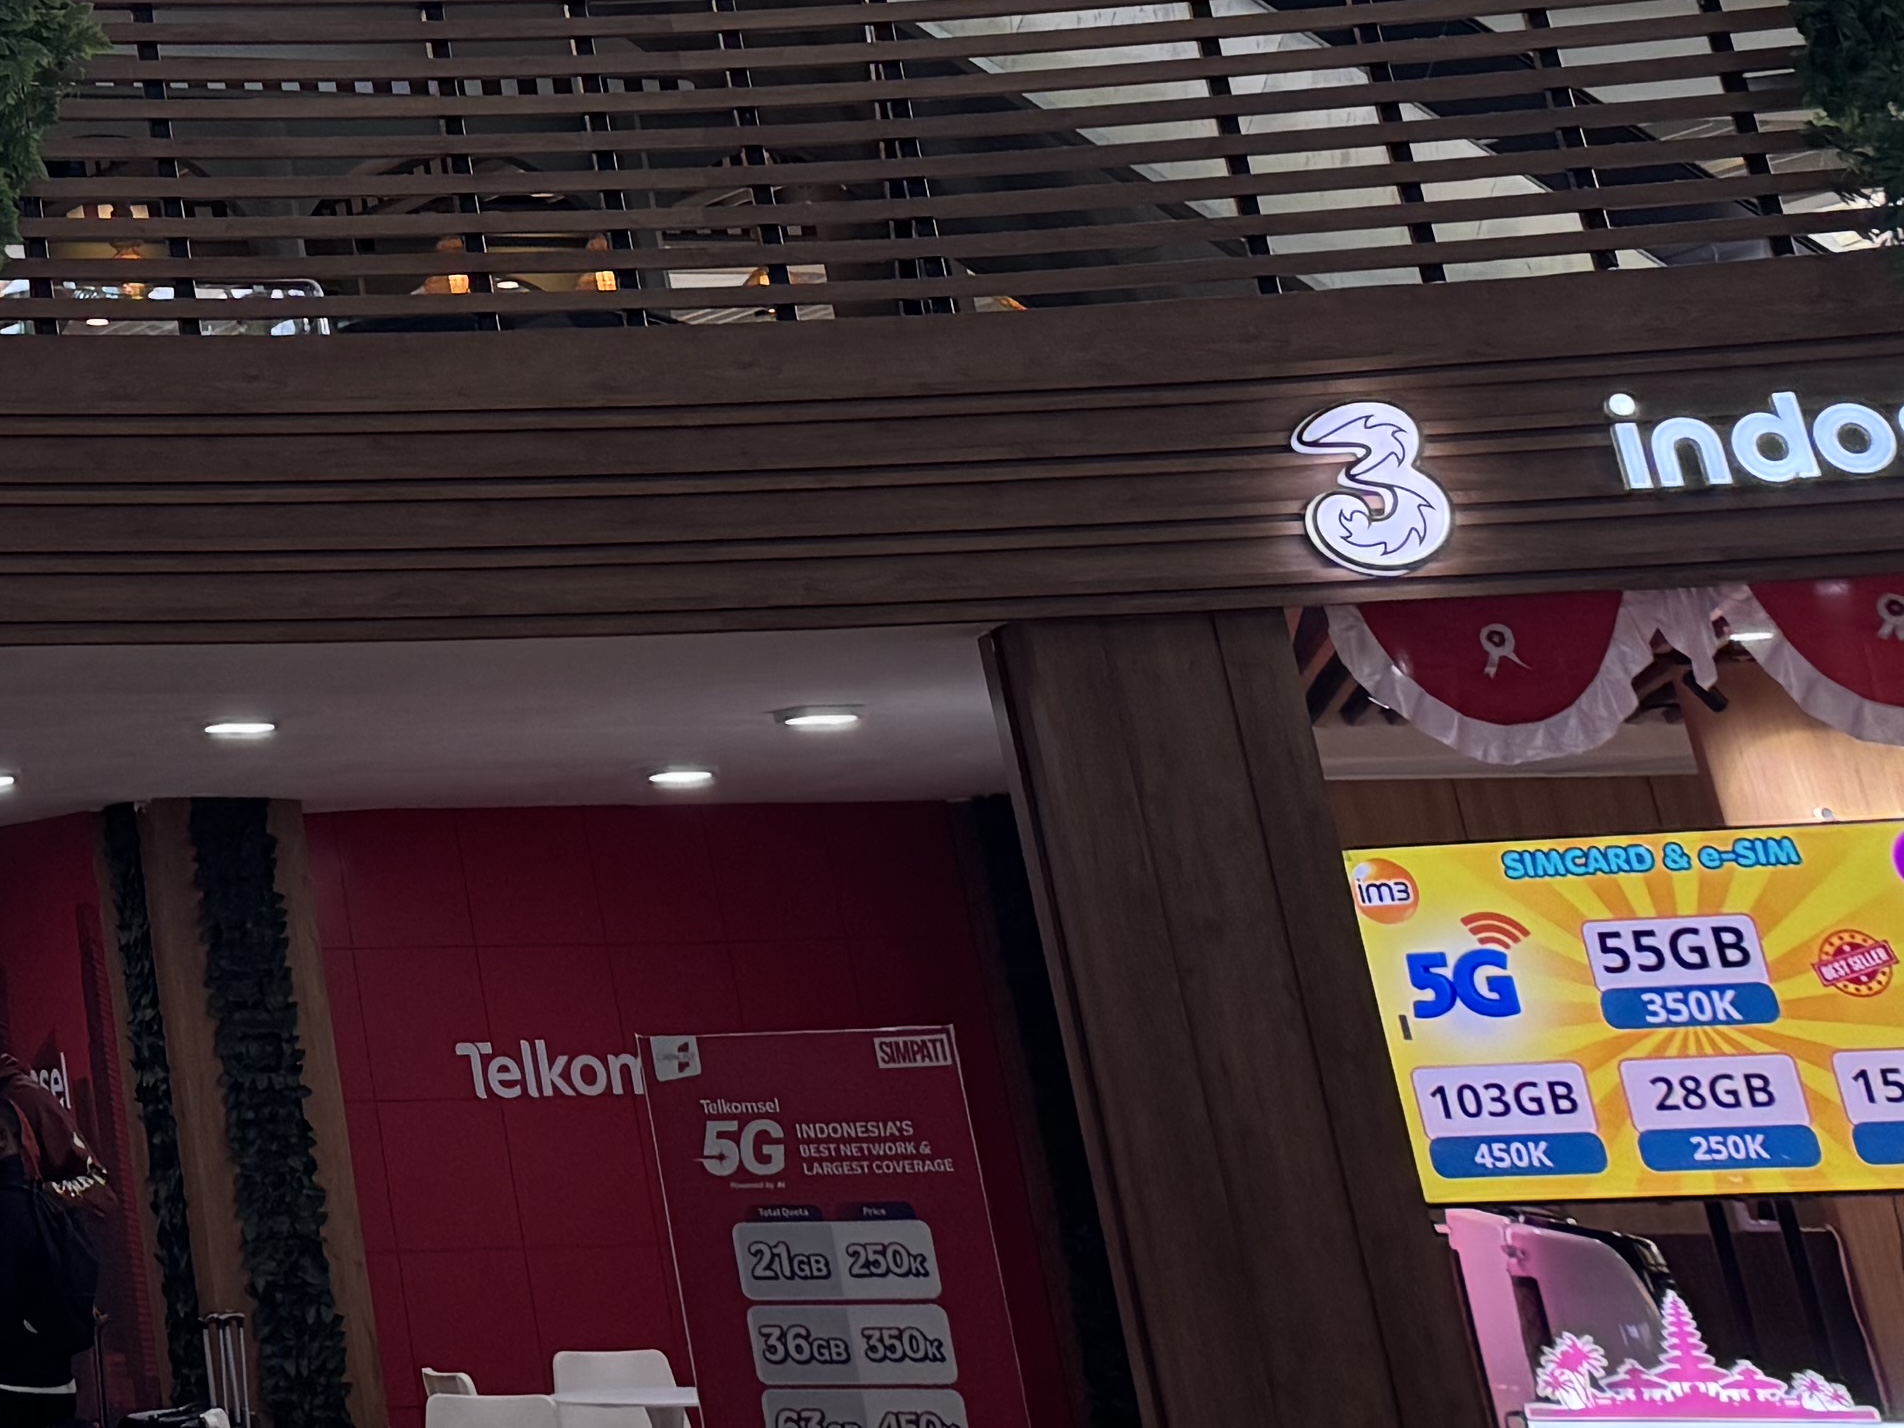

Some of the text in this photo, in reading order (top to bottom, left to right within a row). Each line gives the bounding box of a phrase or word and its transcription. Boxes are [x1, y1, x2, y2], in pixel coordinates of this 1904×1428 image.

[1604, 390, 1904, 494] indo
[1500, 837, 1804, 881] SIMCARD & e-SIM
[1356, 878, 1412, 906] im3
[1595, 924, 1752, 975] 55GB
[1819, 947, 1890, 981] BEST SELLER
[1404, 948, 1523, 1020] 5G
[1644, 988, 1744, 1024] 350K
[878, 1037, 948, 1066] SIMPATI
[699, 1097, 780, 1115] Telkomsel
[1429, 1080, 1580, 1120] 103GB
[1648, 1072, 1777, 1112] 28GB
[702, 1118, 786, 1177] 5G
[795, 1120, 914, 1139] INDONESIA'S
[1689, 1134, 1771, 1162] 250K
[799, 1141, 931, 1158] BEST NETWORK &
[802, 1158, 955, 1176] LARGEST COVERAGE
[1473, 1140, 1554, 1170] 450K
[758, 1207, 781, 1217] Total
[747, 1240, 832, 1280] 21GB
[845, 1241, 930, 1279] 250K
[758, 1324, 851, 1365] 36GB
[861, 1326, 947, 1364] 350K
